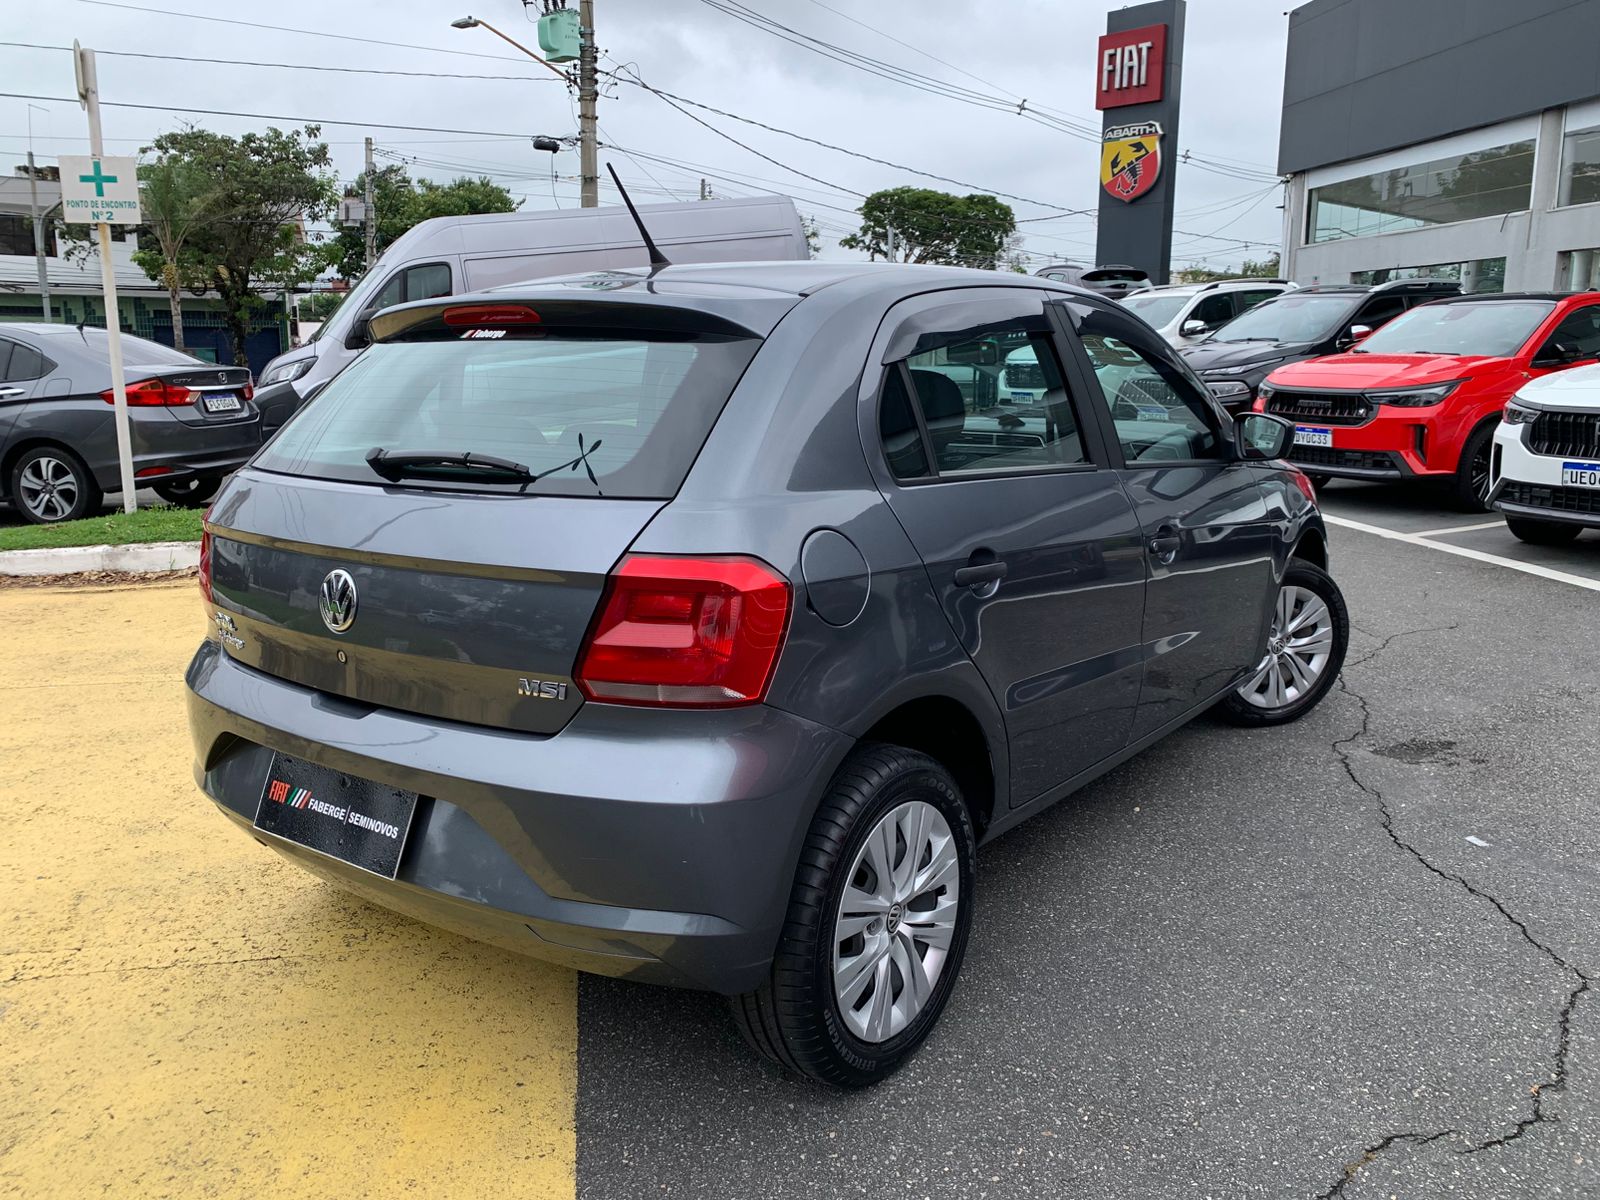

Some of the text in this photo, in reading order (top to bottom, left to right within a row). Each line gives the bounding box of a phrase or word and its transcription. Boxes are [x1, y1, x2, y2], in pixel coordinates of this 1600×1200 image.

[1102, 41, 1152, 92] FIAT
[1105, 125, 1156, 139] ABARTH
[66, 200, 137, 209] PONTO DE ENCONTRO
[105, 211, 114, 220] 2
[1570, 470, 1600, 485] UEO
[518, 678, 567, 700] MSI
[268, 780, 399, 839] FIAT FABERGE SEMINOVOS
